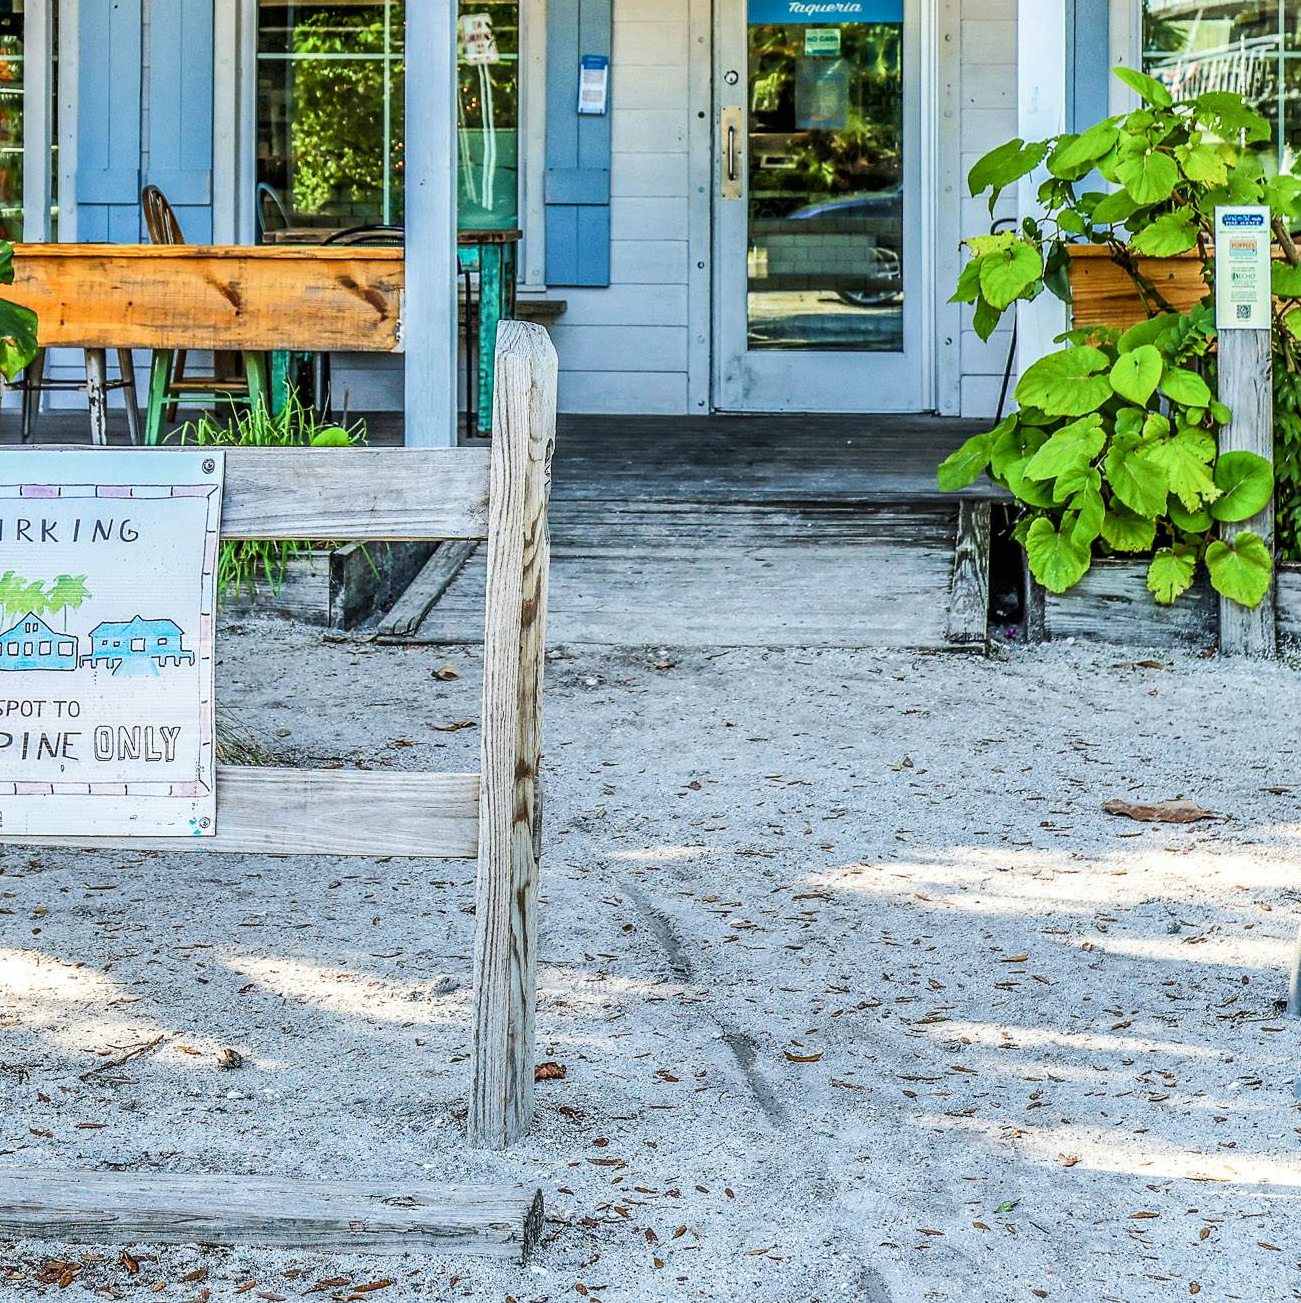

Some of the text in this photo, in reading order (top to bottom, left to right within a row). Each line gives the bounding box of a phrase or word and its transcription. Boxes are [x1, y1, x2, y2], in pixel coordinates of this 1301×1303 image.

[789, 1, 862, 16] Taqueria
[51, 699, 81, 718] TO
[93, 724, 182, 763] ONLY
